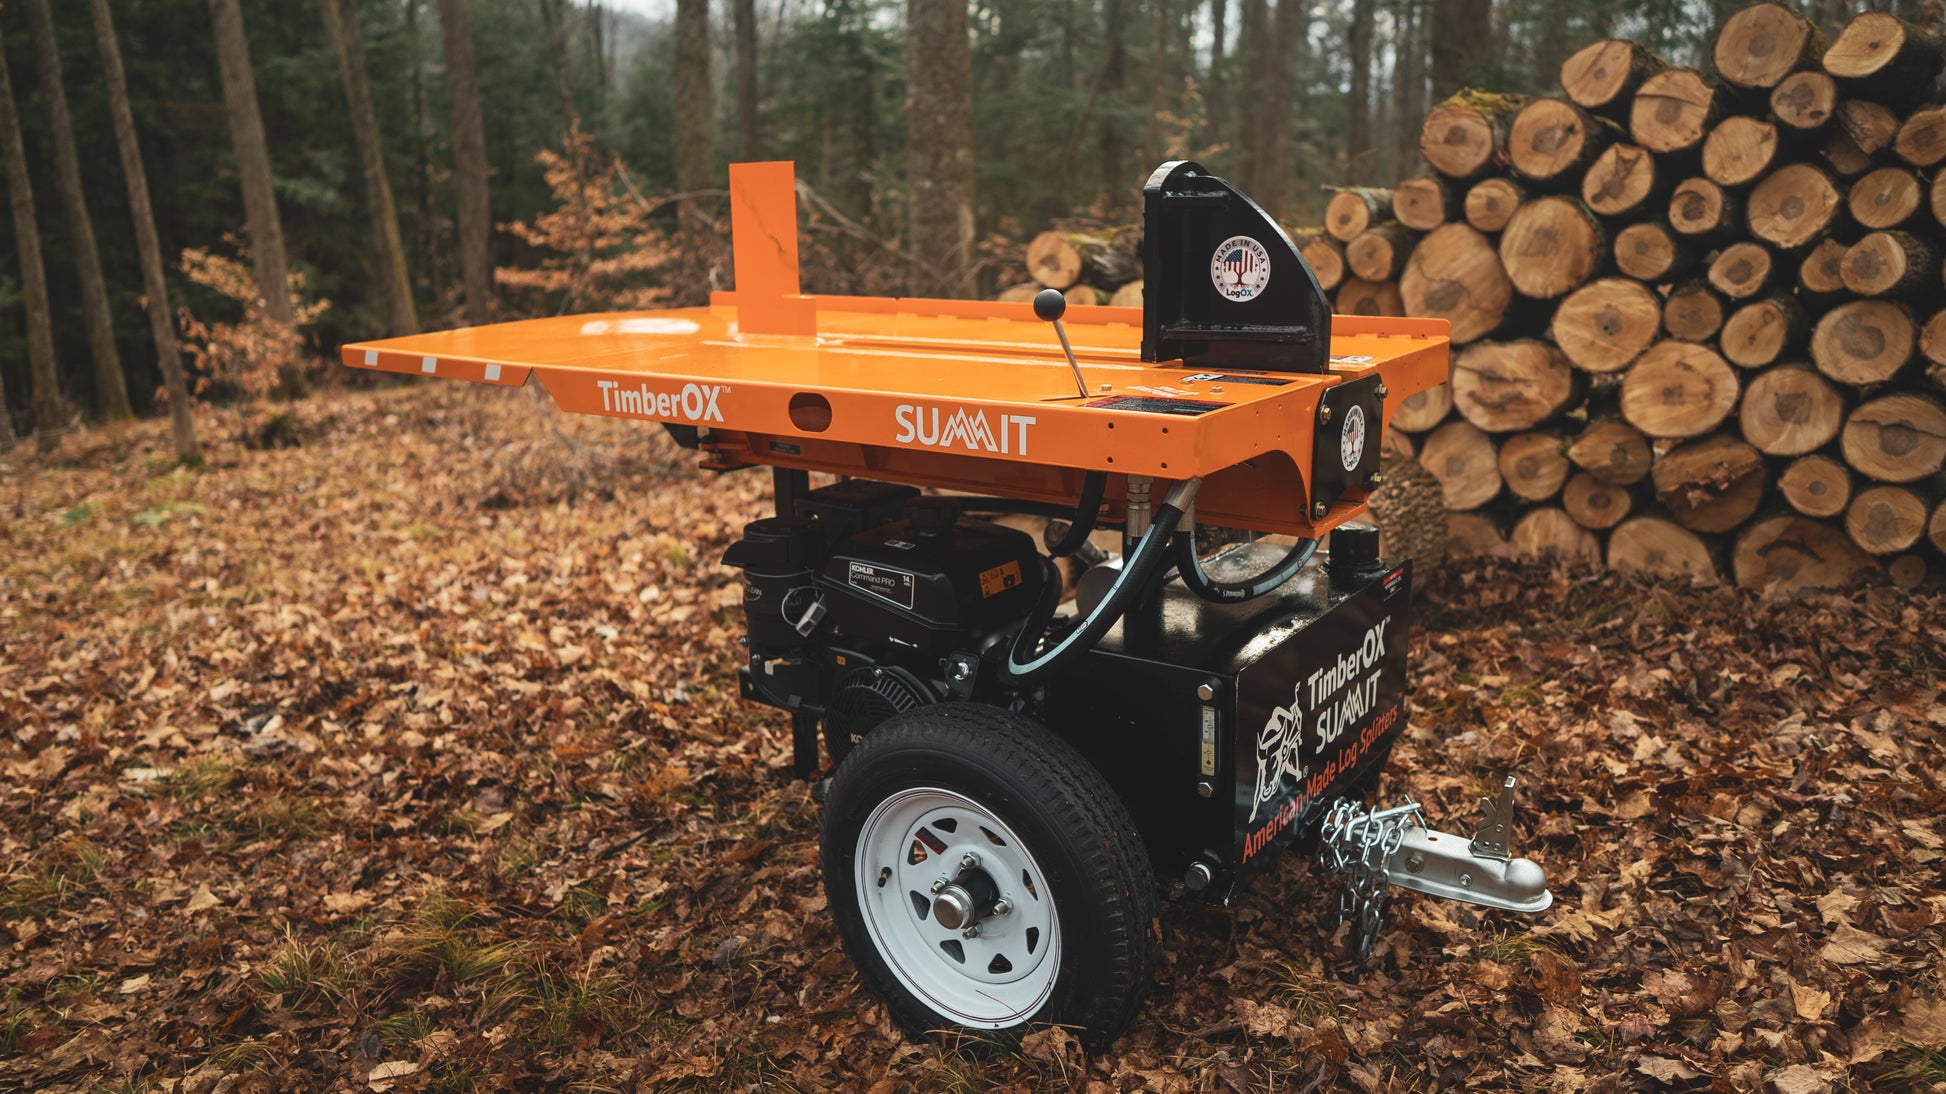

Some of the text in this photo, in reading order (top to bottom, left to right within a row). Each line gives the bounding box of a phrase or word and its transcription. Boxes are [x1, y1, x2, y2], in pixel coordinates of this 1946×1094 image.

[1216, 240, 1237, 263] MADE
[1253, 245, 1265, 264] USA
[1226, 289, 1253, 298] LogOX
[895, 404, 1036, 456] SUMMIT
[850, 571, 880, 584] Command
[881, 577, 895, 587] PRO
[851, 564, 874, 576] KOHLER
[1316, 668, 1381, 755] SUMMIT
[1243, 704, 1398, 864] American Made Log Splitters
